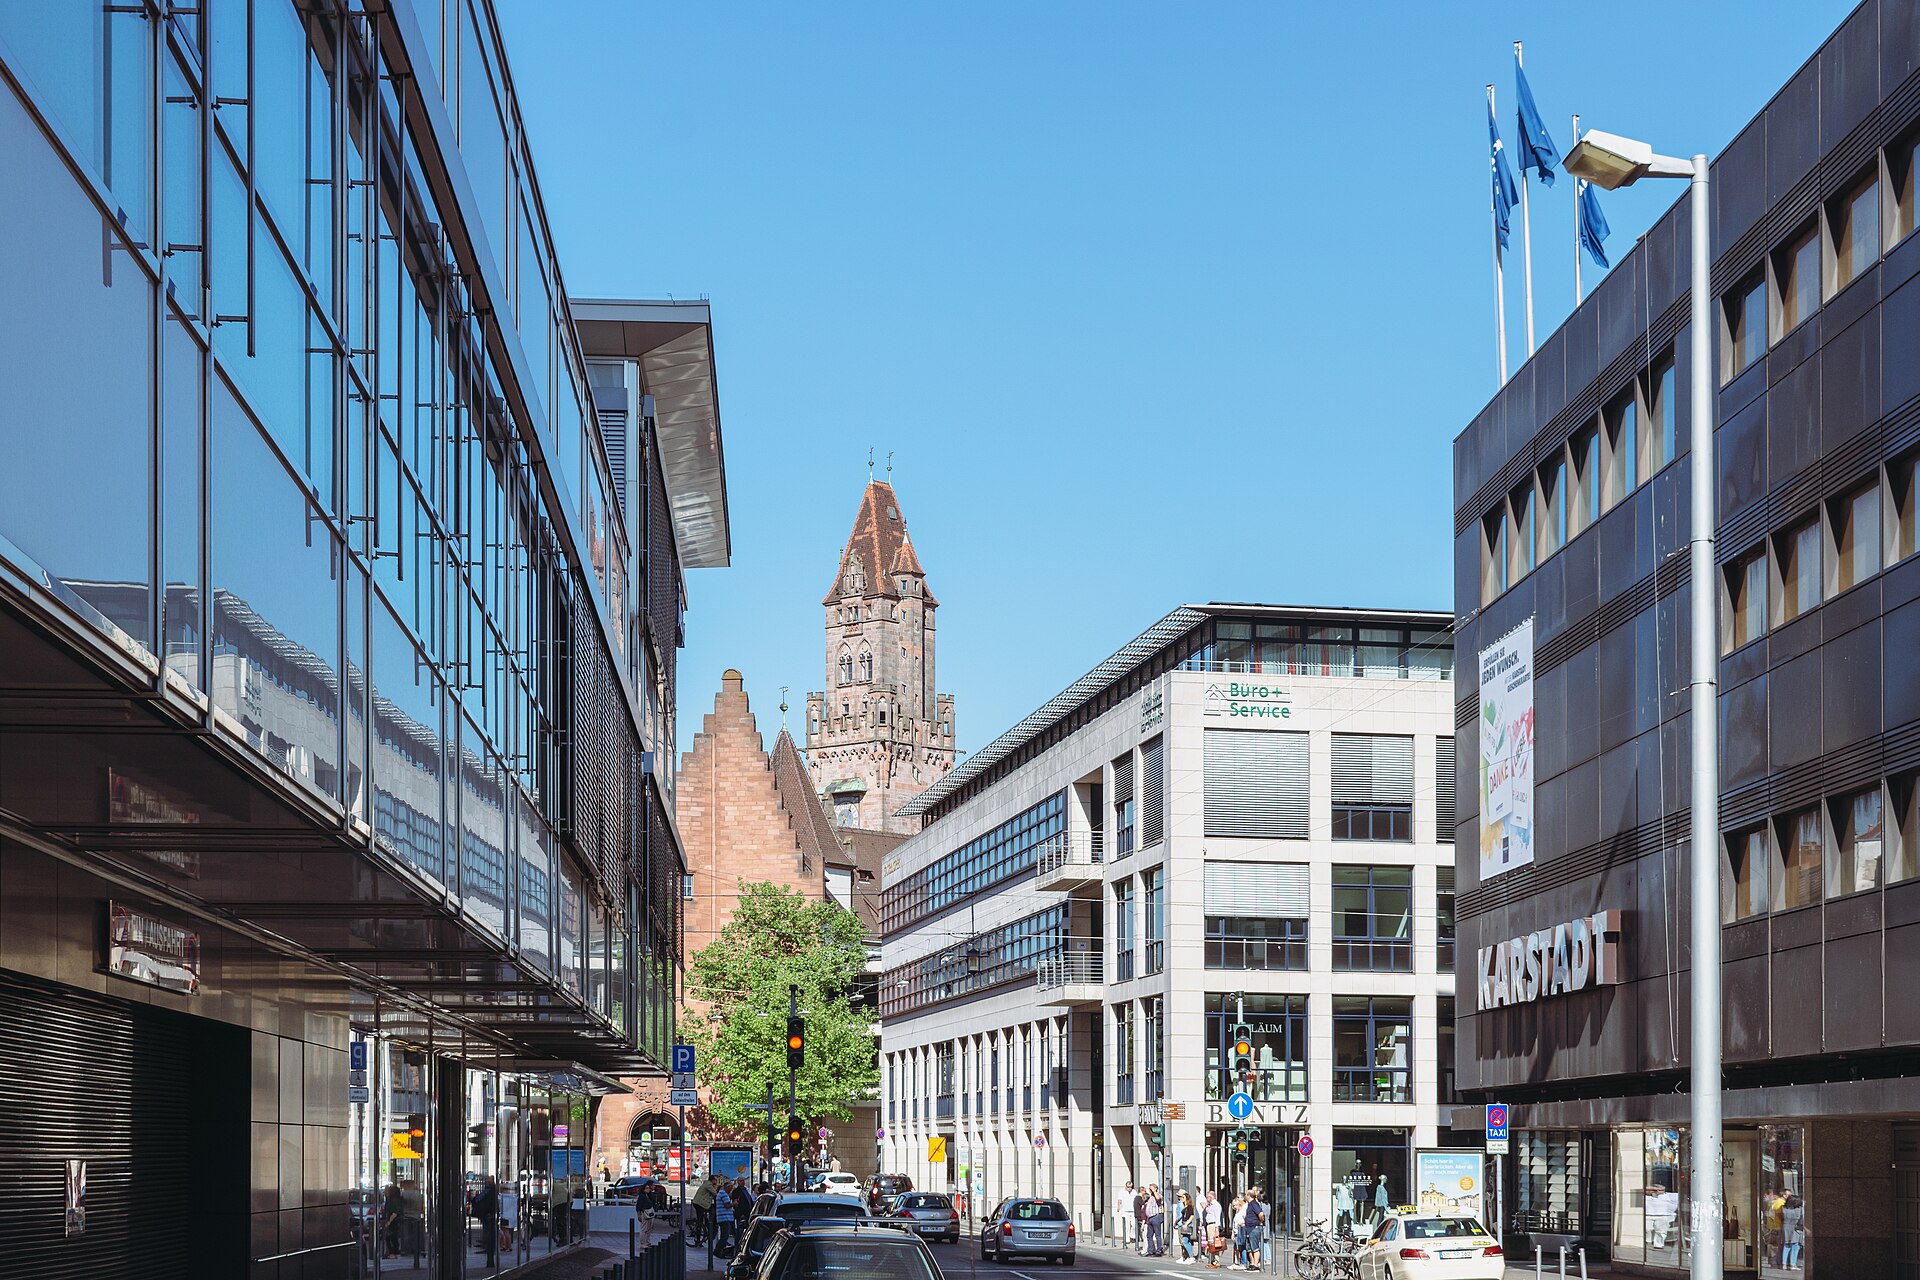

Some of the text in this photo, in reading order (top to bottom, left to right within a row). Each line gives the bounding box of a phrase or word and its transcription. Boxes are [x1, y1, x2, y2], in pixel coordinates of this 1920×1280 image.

[1481, 665, 1496, 686] JEDEN
[1230, 682, 1269, 697] Büro
[1230, 702, 1290, 718] Service
[1490, 758, 1508, 794] DANKE
[1478, 909, 1617, 1011] KARSTADT
[1227, 1022, 1283, 1033] JLÄUM
[677, 1048, 690, 1069] P
[1208, 1104, 1308, 1123] BNTZ
[1489, 1128, 1506, 1137] TAXI
